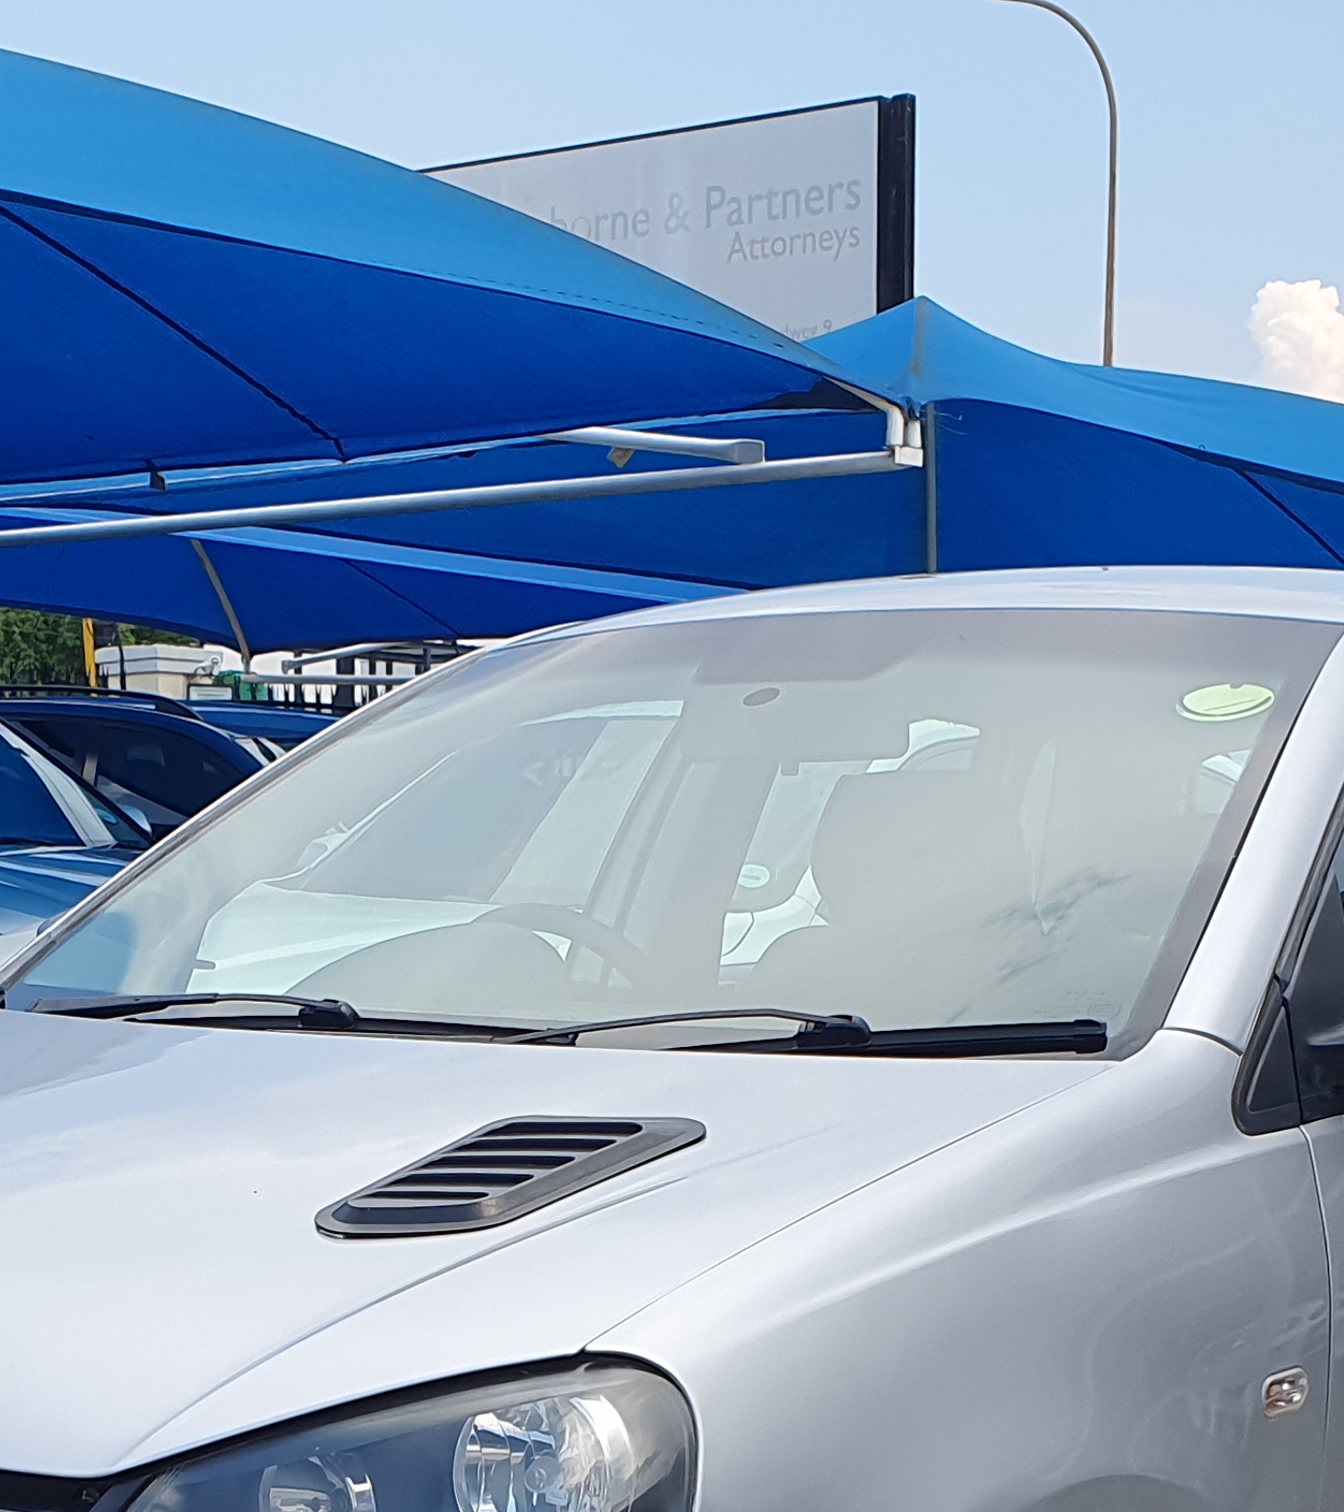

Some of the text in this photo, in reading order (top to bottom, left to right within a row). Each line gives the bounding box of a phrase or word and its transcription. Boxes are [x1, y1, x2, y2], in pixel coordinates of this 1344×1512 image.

[664, 191, 692, 234] &
[706, 179, 862, 229] Partners
[726, 226, 861, 264] Attorneys
